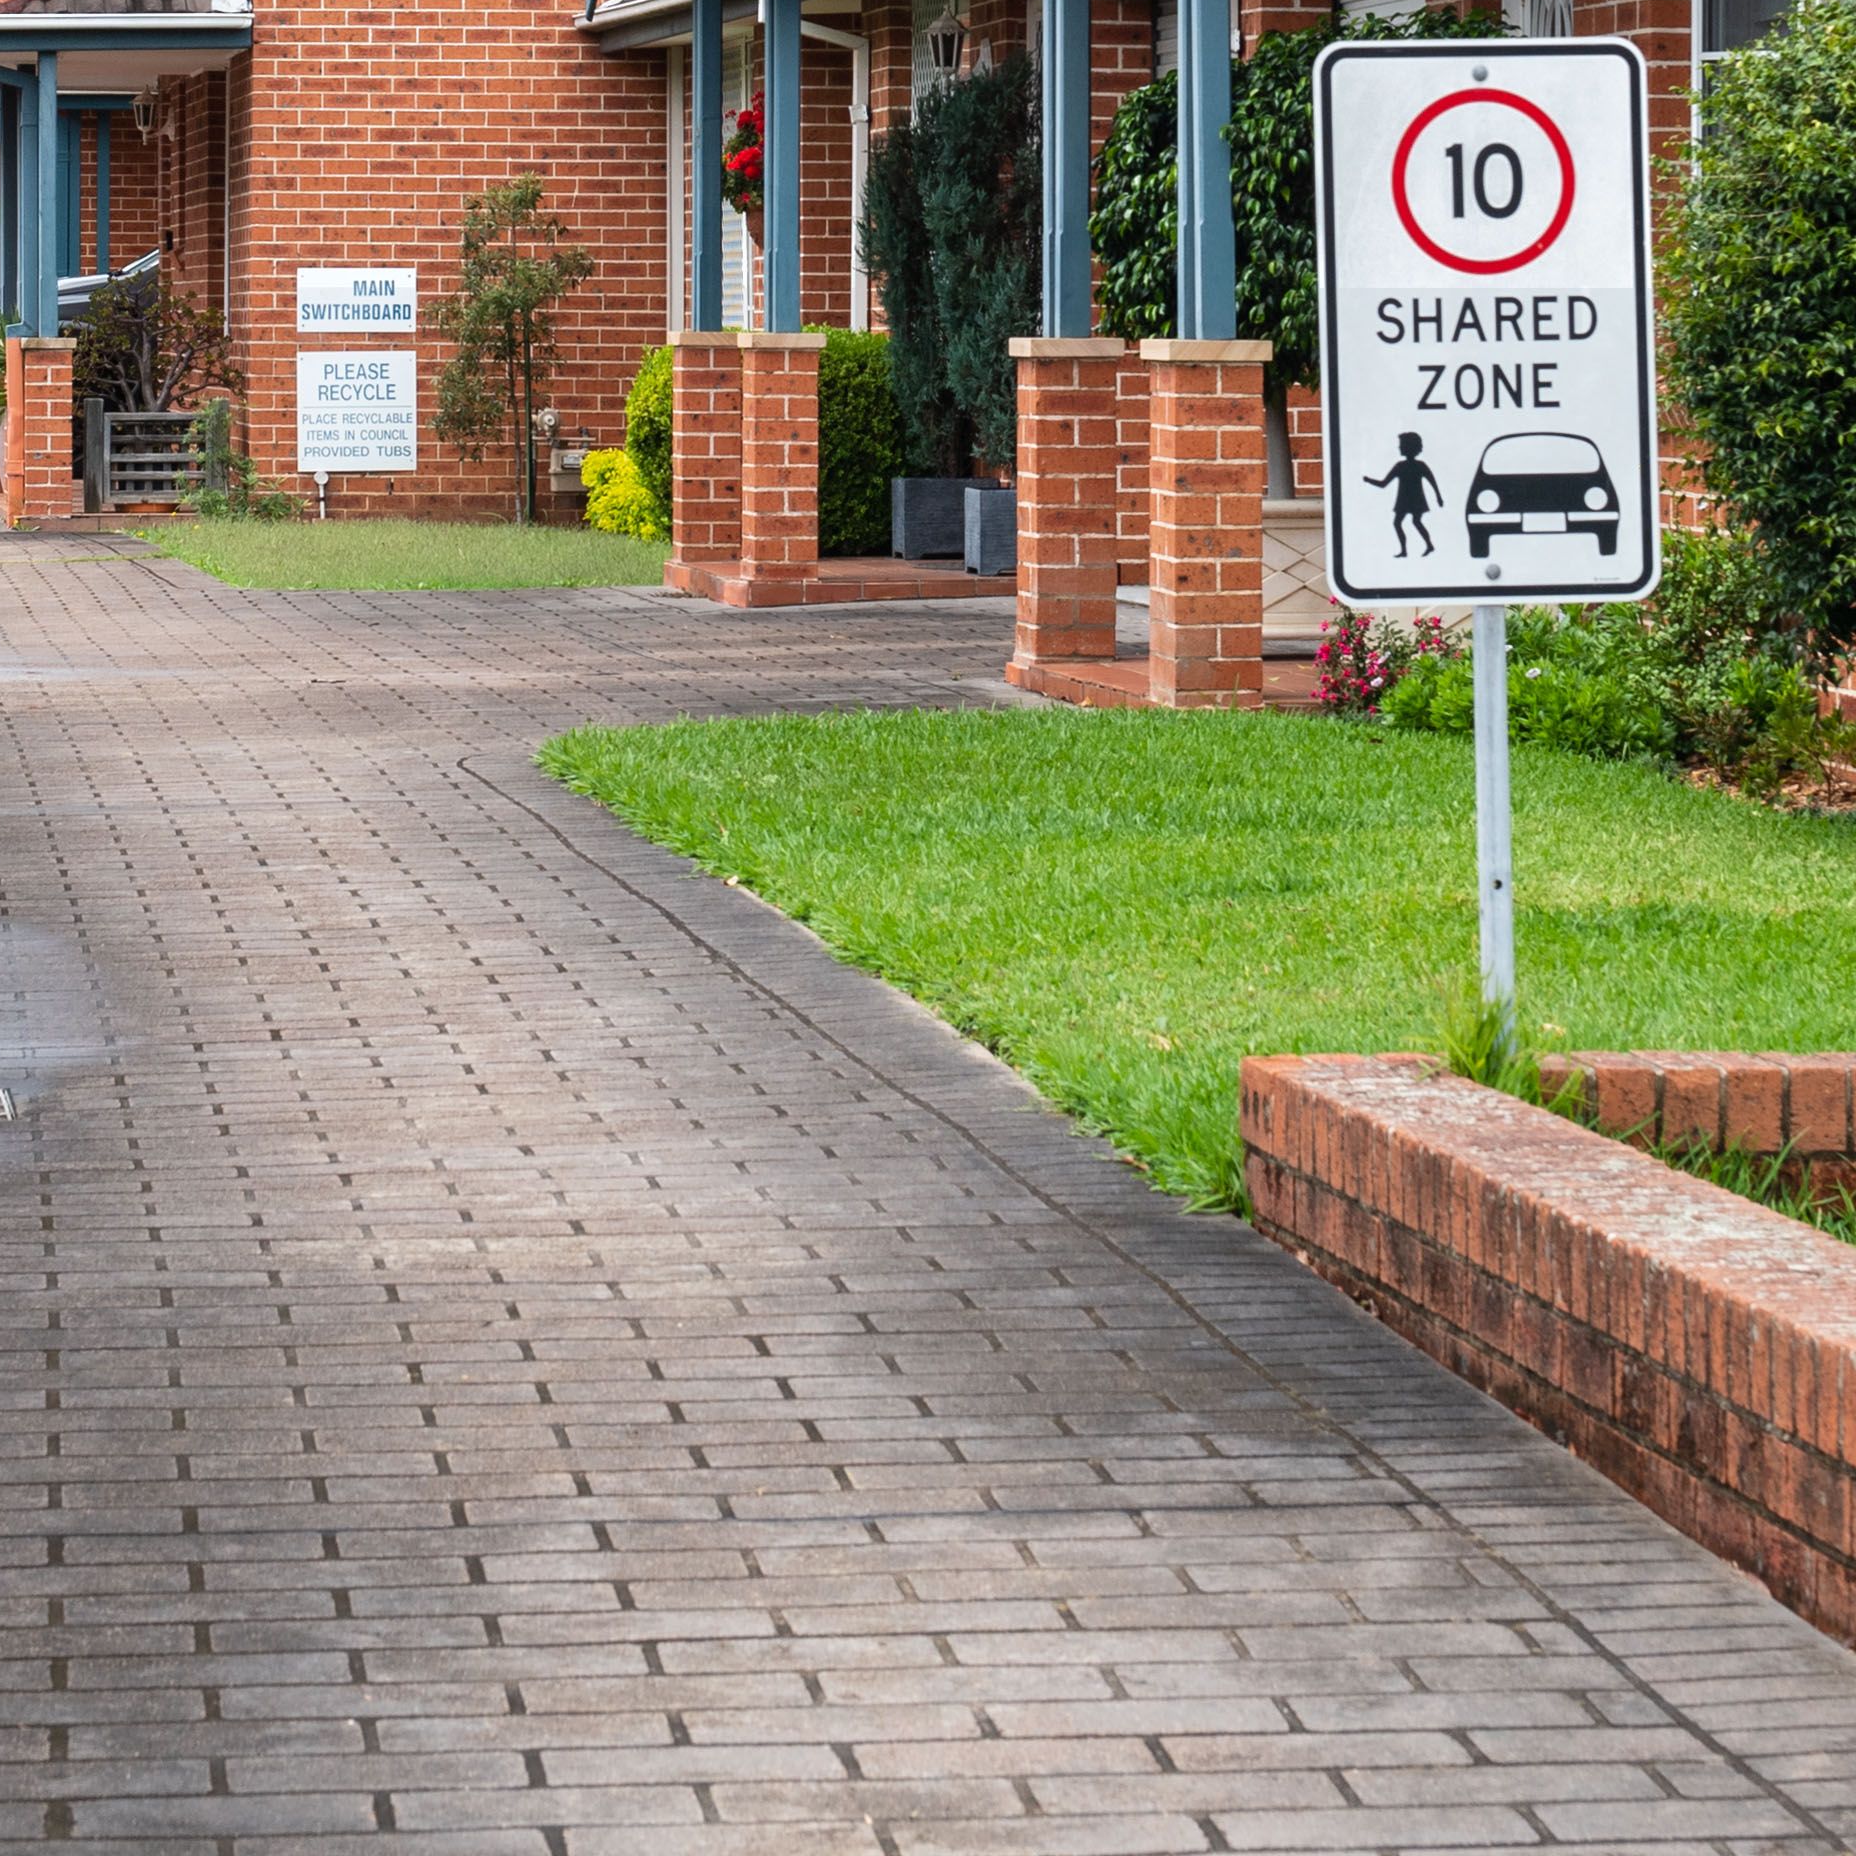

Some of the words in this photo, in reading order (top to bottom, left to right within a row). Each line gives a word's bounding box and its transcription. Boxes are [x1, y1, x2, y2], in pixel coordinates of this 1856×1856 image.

[1444, 141, 1524, 220] 10
[352, 279, 396, 297] MAIN
[301, 303, 412, 321] SWITCHBOARD
[1375, 294, 1599, 346] SHARED
[323, 362, 390, 380] PLEASE
[317, 383, 397, 401] RECYCLE
[1416, 362, 1562, 411] ZONE
[302, 412, 338, 425] PLACE
[342, 412, 413, 425] RECYCLABLE
[306, 429, 340, 441] ITEMS
[344, 429, 355, 441] IN
[359, 428, 409, 441] COUNCIL
[303, 445, 370, 458] PROVIDED
[375, 445, 412, 457] TUBS
